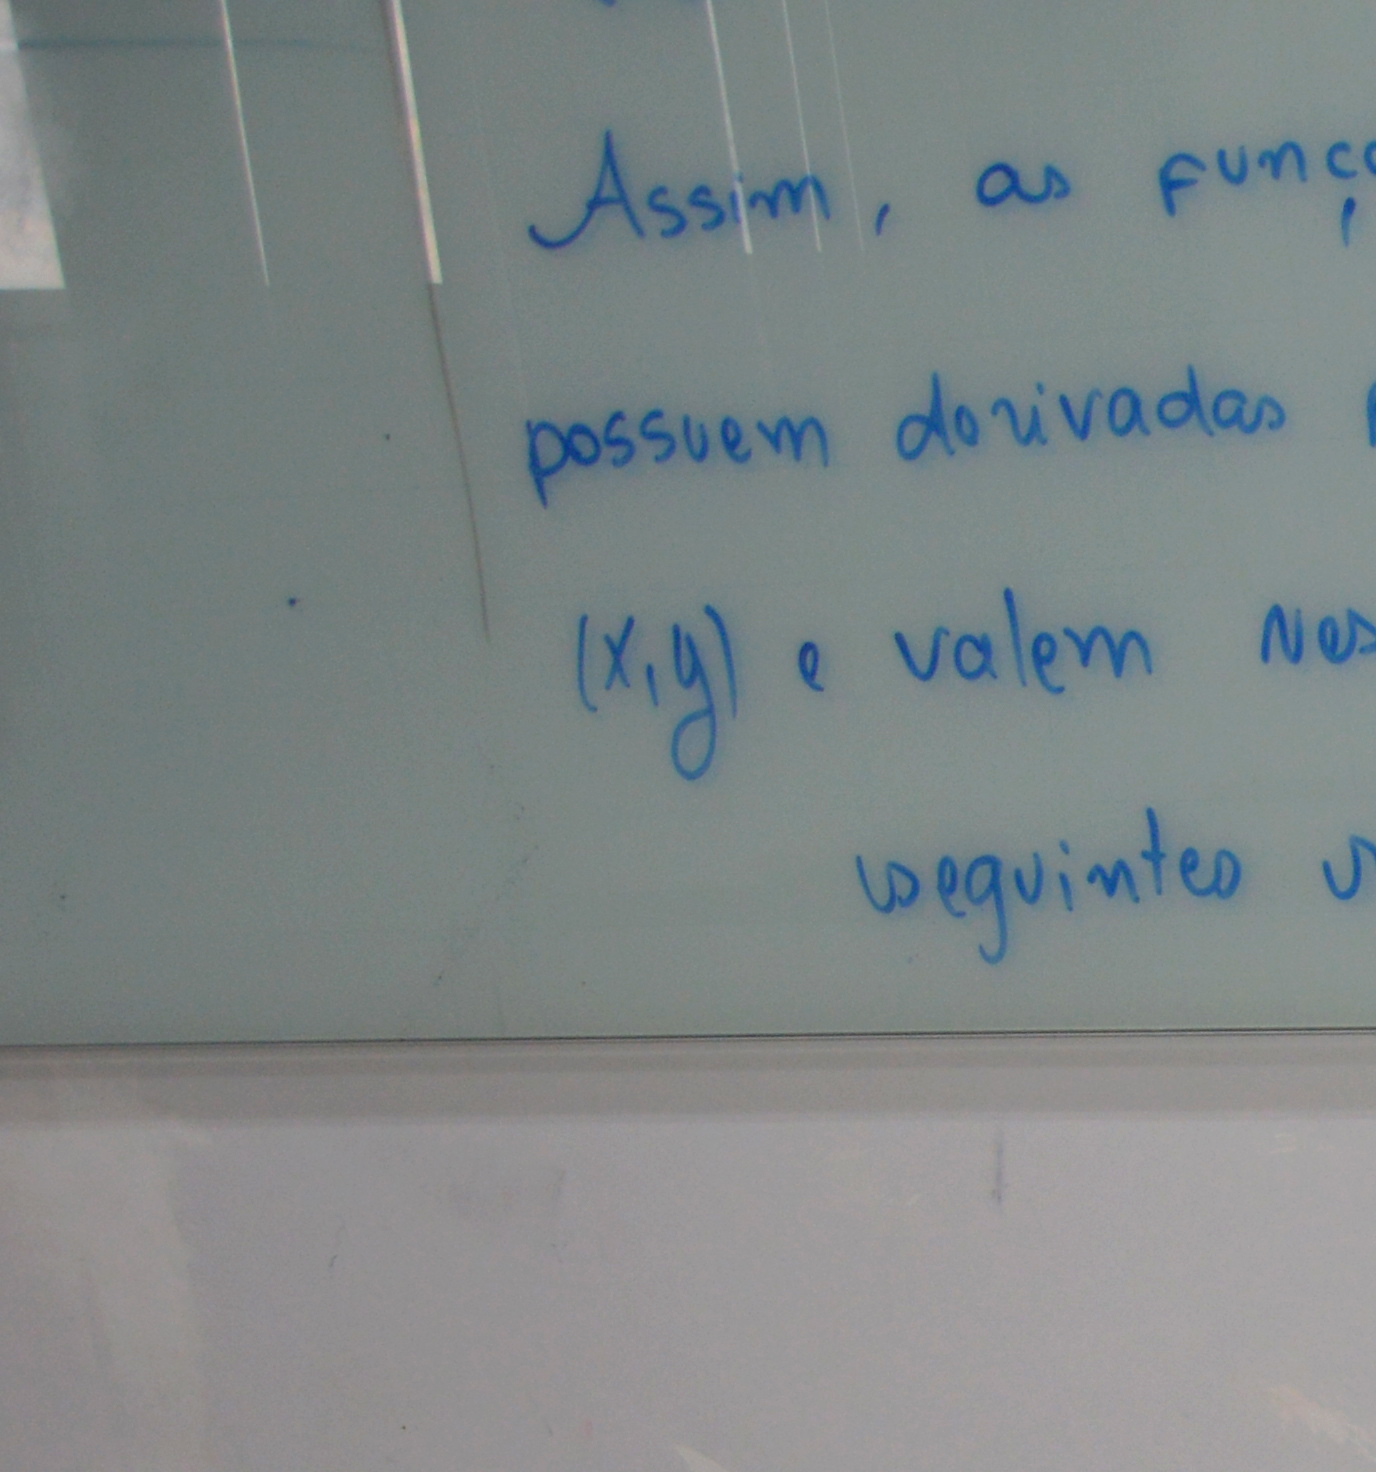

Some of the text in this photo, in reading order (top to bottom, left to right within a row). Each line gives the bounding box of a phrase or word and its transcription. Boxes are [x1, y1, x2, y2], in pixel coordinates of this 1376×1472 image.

[973, 159, 1076, 210] as
[523, 403, 832, 507] possuem
[796, 638, 827, 693] e
[892, 585, 1156, 698] valem
[855, 804, 1246, 966] seguintes
